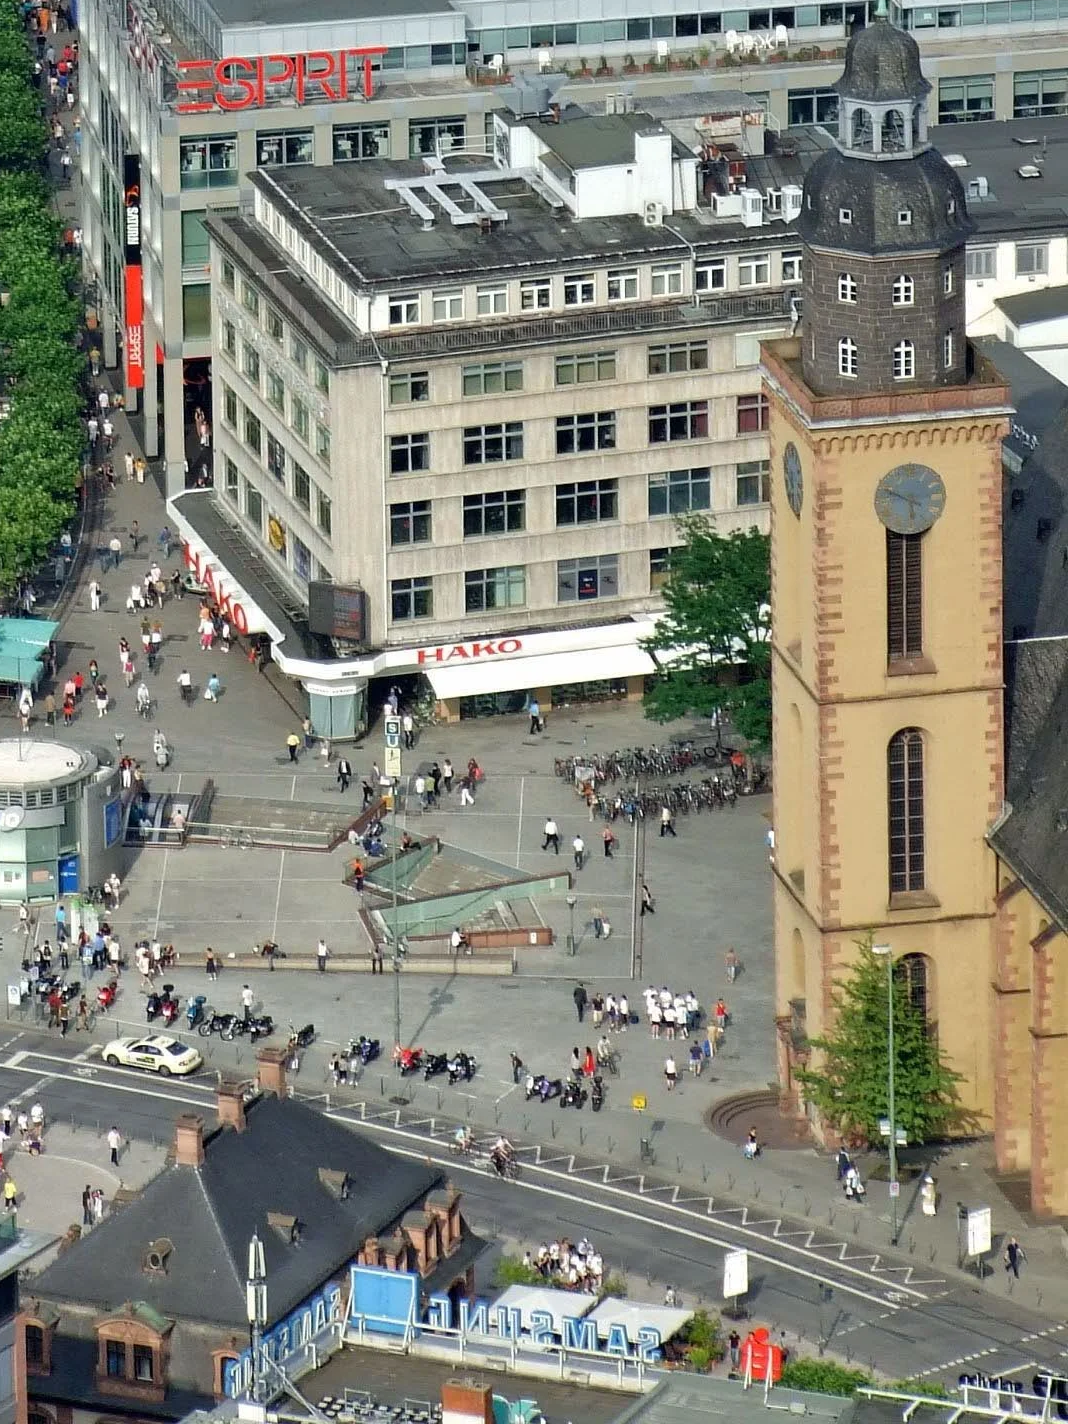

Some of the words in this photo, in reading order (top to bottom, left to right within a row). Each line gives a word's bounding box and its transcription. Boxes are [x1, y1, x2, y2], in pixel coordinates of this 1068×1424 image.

[176, 46, 389, 113] ESPRIT
[126, 207, 139, 245] SATURN
[129, 326, 141, 368] ESPRIT
[181, 539, 249, 636] HAKO
[417, 639, 523, 665] HAKO
[387, 736, 399, 748] U
